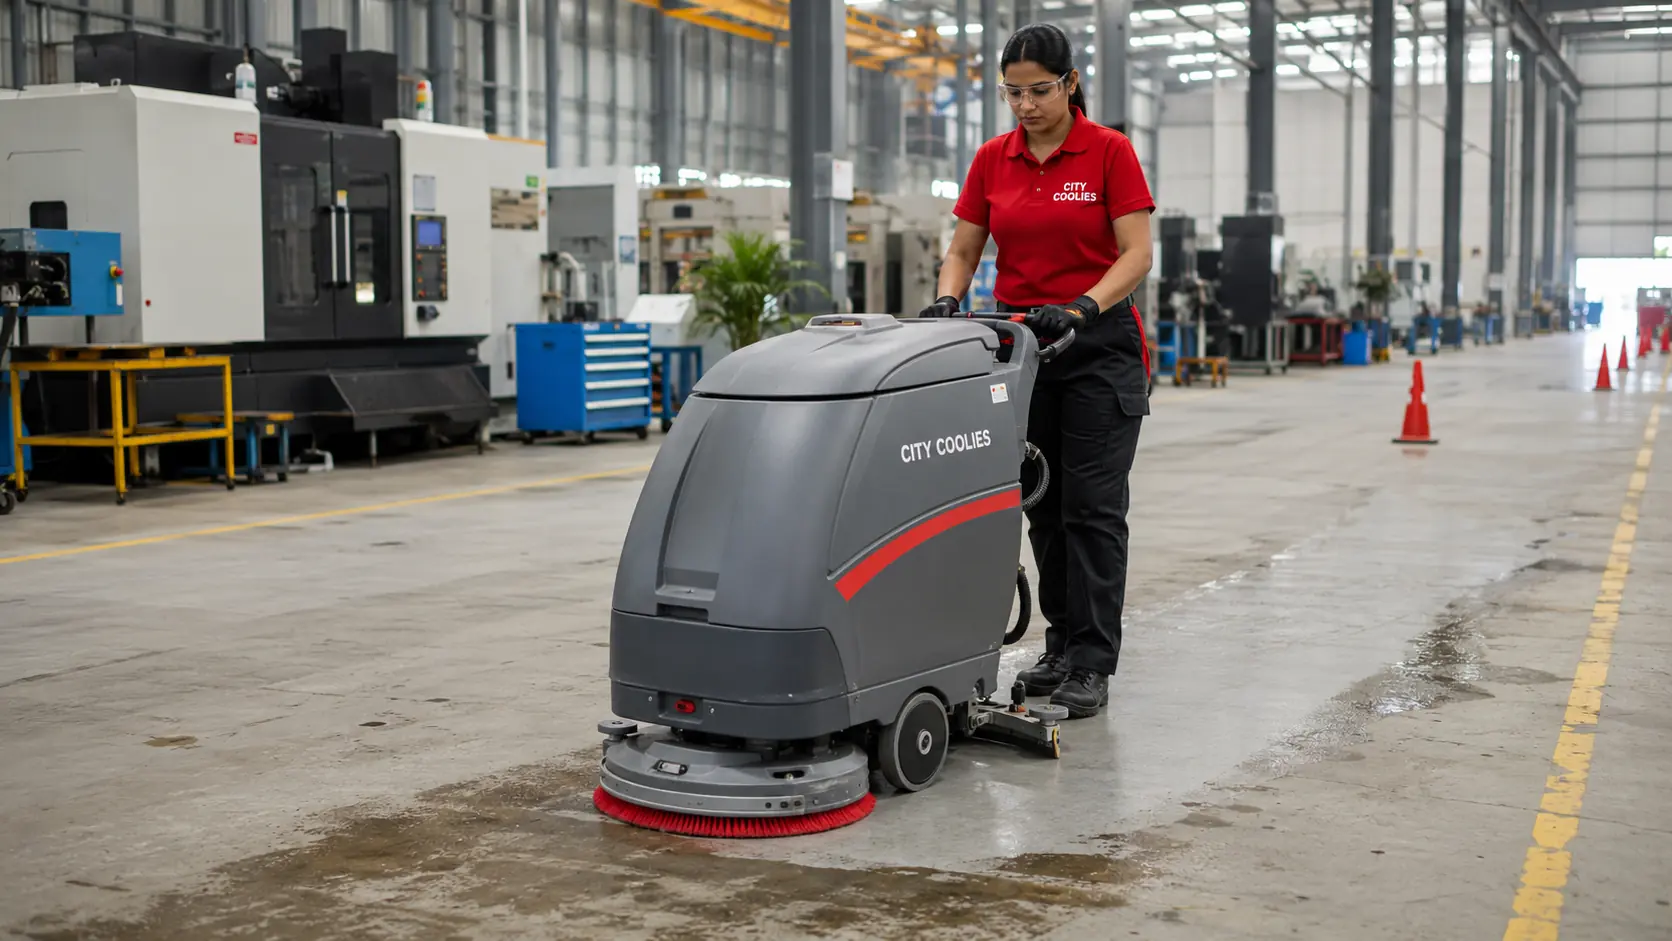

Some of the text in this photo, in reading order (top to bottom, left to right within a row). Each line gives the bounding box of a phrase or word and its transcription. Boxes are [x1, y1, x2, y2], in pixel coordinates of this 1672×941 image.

[1063, 182, 1087, 192] CITY
[1053, 192, 1097, 202] COOLIES
[900, 429, 992, 463] CITY COOLIES
